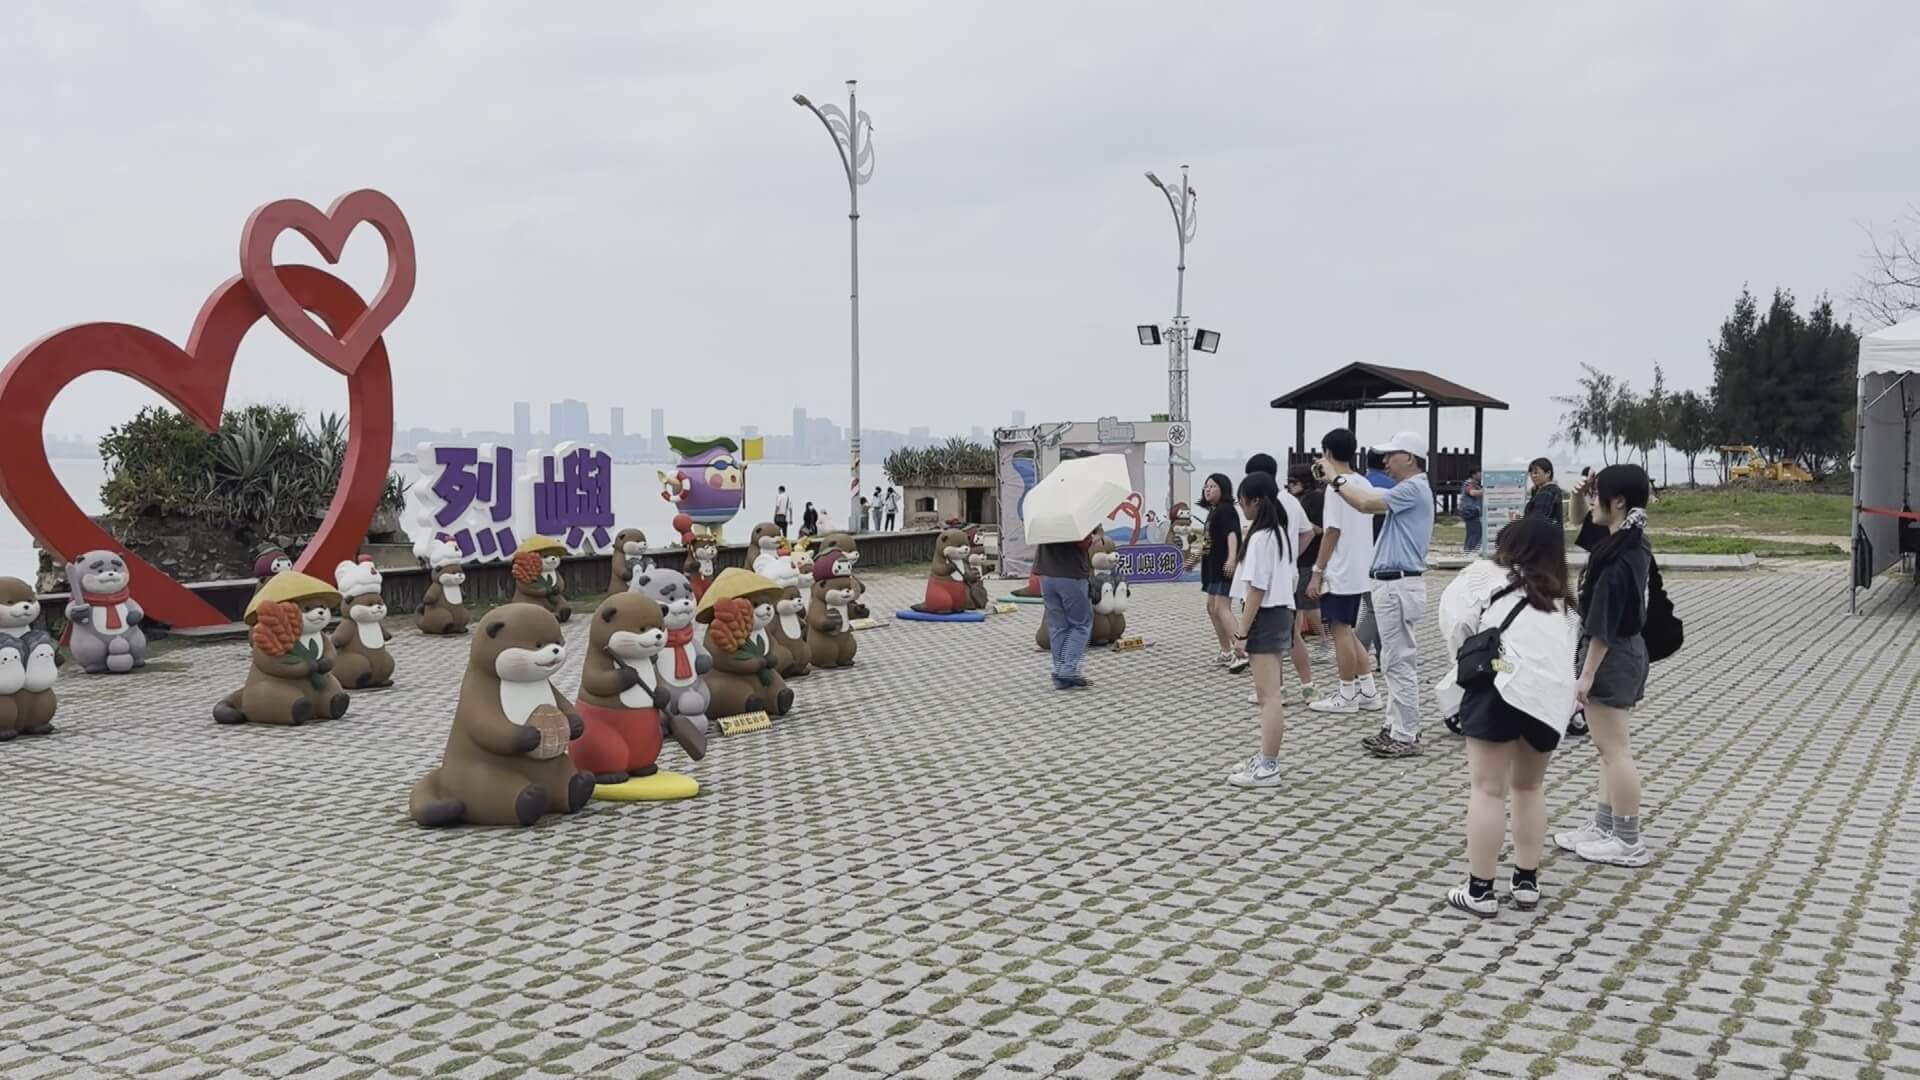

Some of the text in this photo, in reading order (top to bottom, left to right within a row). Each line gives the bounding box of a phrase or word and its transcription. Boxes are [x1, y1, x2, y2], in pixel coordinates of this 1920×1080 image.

[433, 446, 615, 556] 烈嶼
[1116, 551, 1178, 576] 烈嶼鄉
